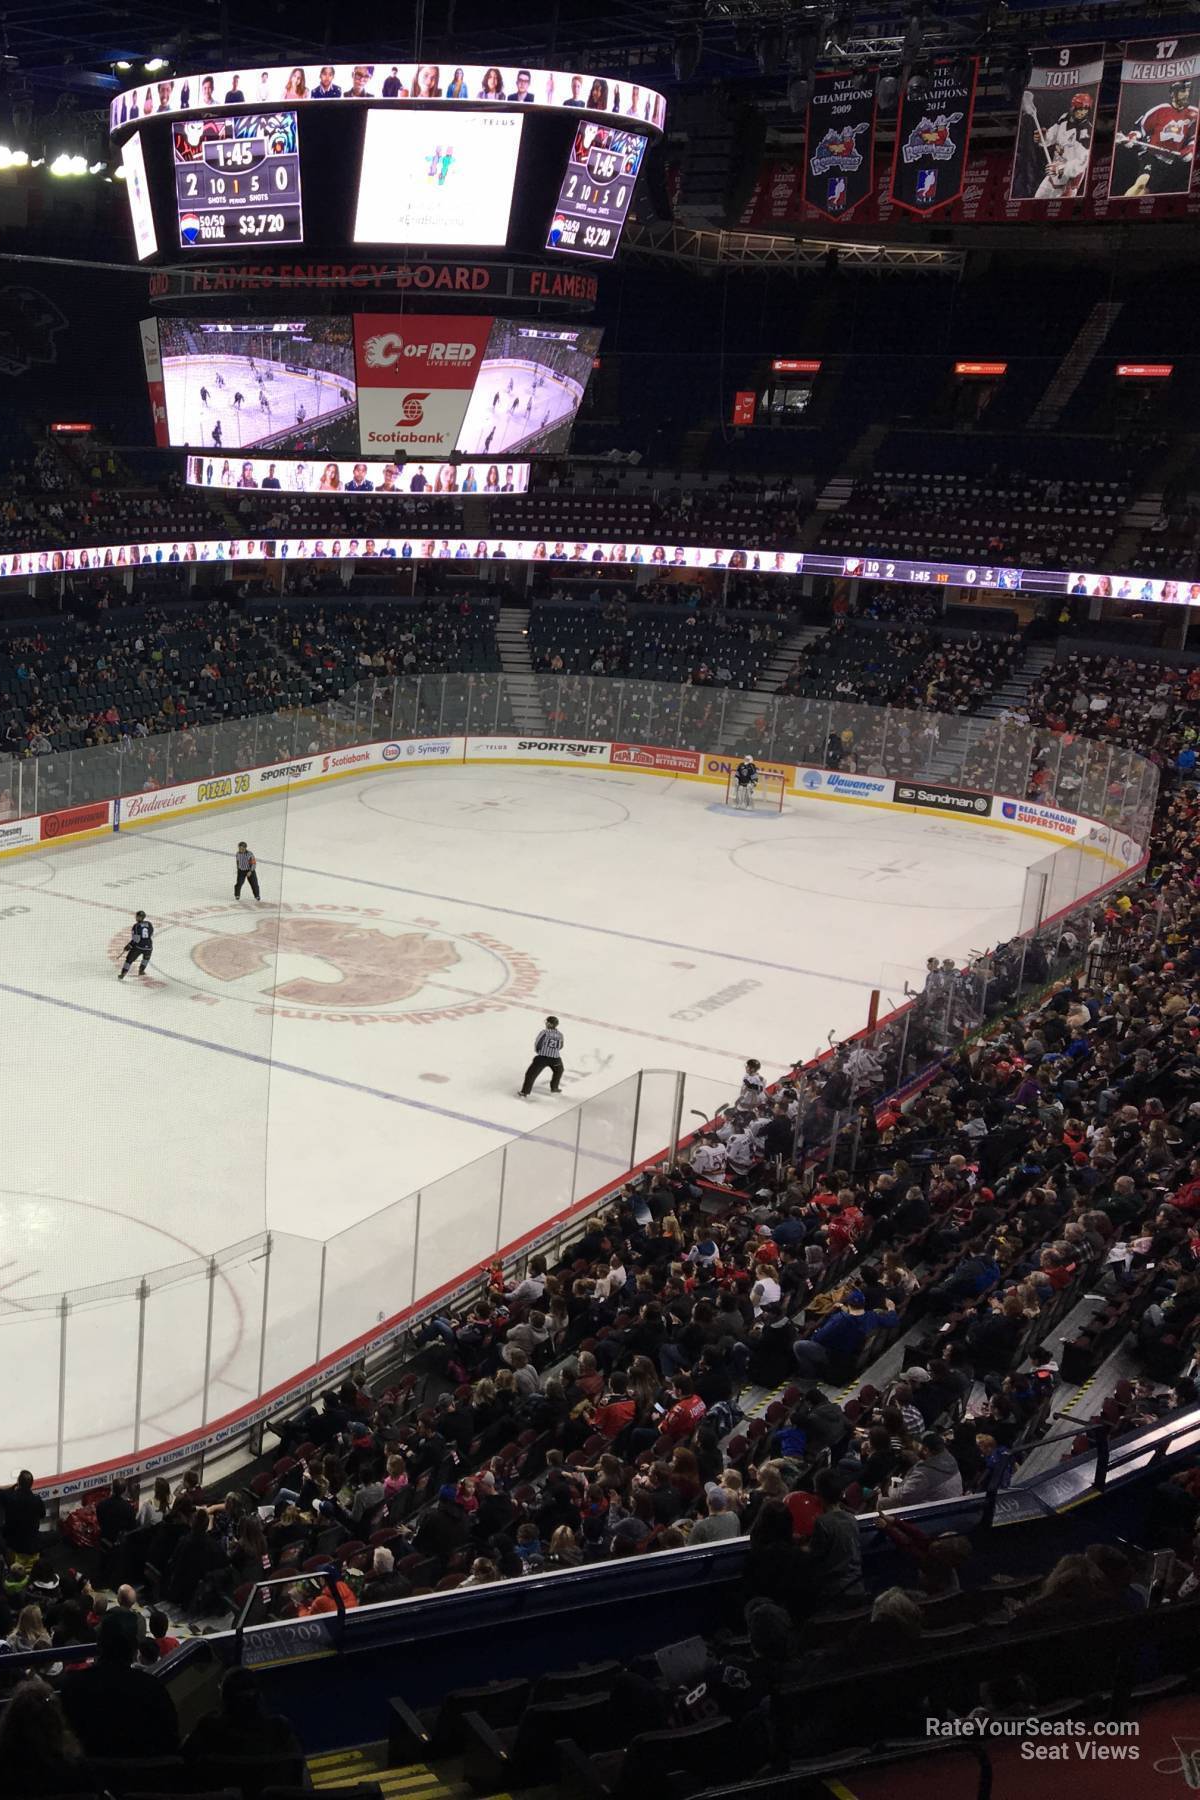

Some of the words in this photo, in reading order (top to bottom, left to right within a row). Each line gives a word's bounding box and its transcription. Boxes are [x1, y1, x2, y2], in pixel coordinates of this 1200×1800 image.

[1058, 48, 1071, 67] 9
[1155, 39, 1179, 60] 17
[1045, 69, 1080, 86] TOTH
[1131, 59, 1197, 80] KELUSKY
[812, 89, 873, 105] CHAMPIONS
[926, 101, 947, 112] 2014
[831, 103, 853, 115] 2009
[483, 118, 516, 127] TELUS
[217, 142, 253, 167] 1:45
[593, 152, 617, 178] 1:45
[186, 173, 198, 196] 2
[210, 178, 226, 195] 10
[233, 179, 240, 194] 1
[251, 175, 260, 192] 5
[275, 166, 288, 191] 0
[208, 197, 227, 205] SHOTS
[249, 193, 269, 202] SHOTS
[566, 174, 578, 198] 2
[581, 184, 592, 201] 10
[602, 189, 611, 205] 5
[615, 185, 626, 208] 0
[199, 214, 226, 227] 50/50
[239, 213, 285, 237] $3,720
[201, 226, 226, 239] TOTAL
[194, 267, 273, 292] FLAMES
[279, 264, 391, 290] ENERGY
[400, 264, 490, 292] BOARD
[529, 270, 583, 299] FLAMES
[403, 344, 428, 358] OF
[428, 342, 477, 360] RED
[367, 431, 445, 444] Scotiabank
[867, 561, 880, 572] 10
[886, 563, 896, 578] 2
[910, 570, 931, 582] 1:45
[965, 569, 977, 584] 0
[985, 570, 993, 581] 5
[417, 744, 451, 755] Synergy
[517, 741, 608, 755] SPORTSNET
[331, 751, 370, 768] Scotiabank
[707, 761, 730, 774] ON
[198, 777, 233, 802] PIZZA
[234, 773, 251, 793] 73
[260, 761, 313, 782] SPORTSNET
[827, 774, 886, 792] Wawanesa
[833, 785, 870, 798] Insurance
[917, 790, 974, 809] Sandman
[126, 792, 187, 817] Budweiser
[1017, 812, 1077, 836] SUPERSTORE
[1018, 805, 1038, 816] REAL
[1039, 809, 1078, 826] CANADIAN
[549, 1039, 558, 1049] 21
[83, 1476, 108, 1490] KEEPING
[116, 1467, 134, 1480] FRESH
[163, 1449, 185, 1464] KEEPING
[190, 1440, 207, 1455] FRESH
[284, 1623, 321, 1642] 209
